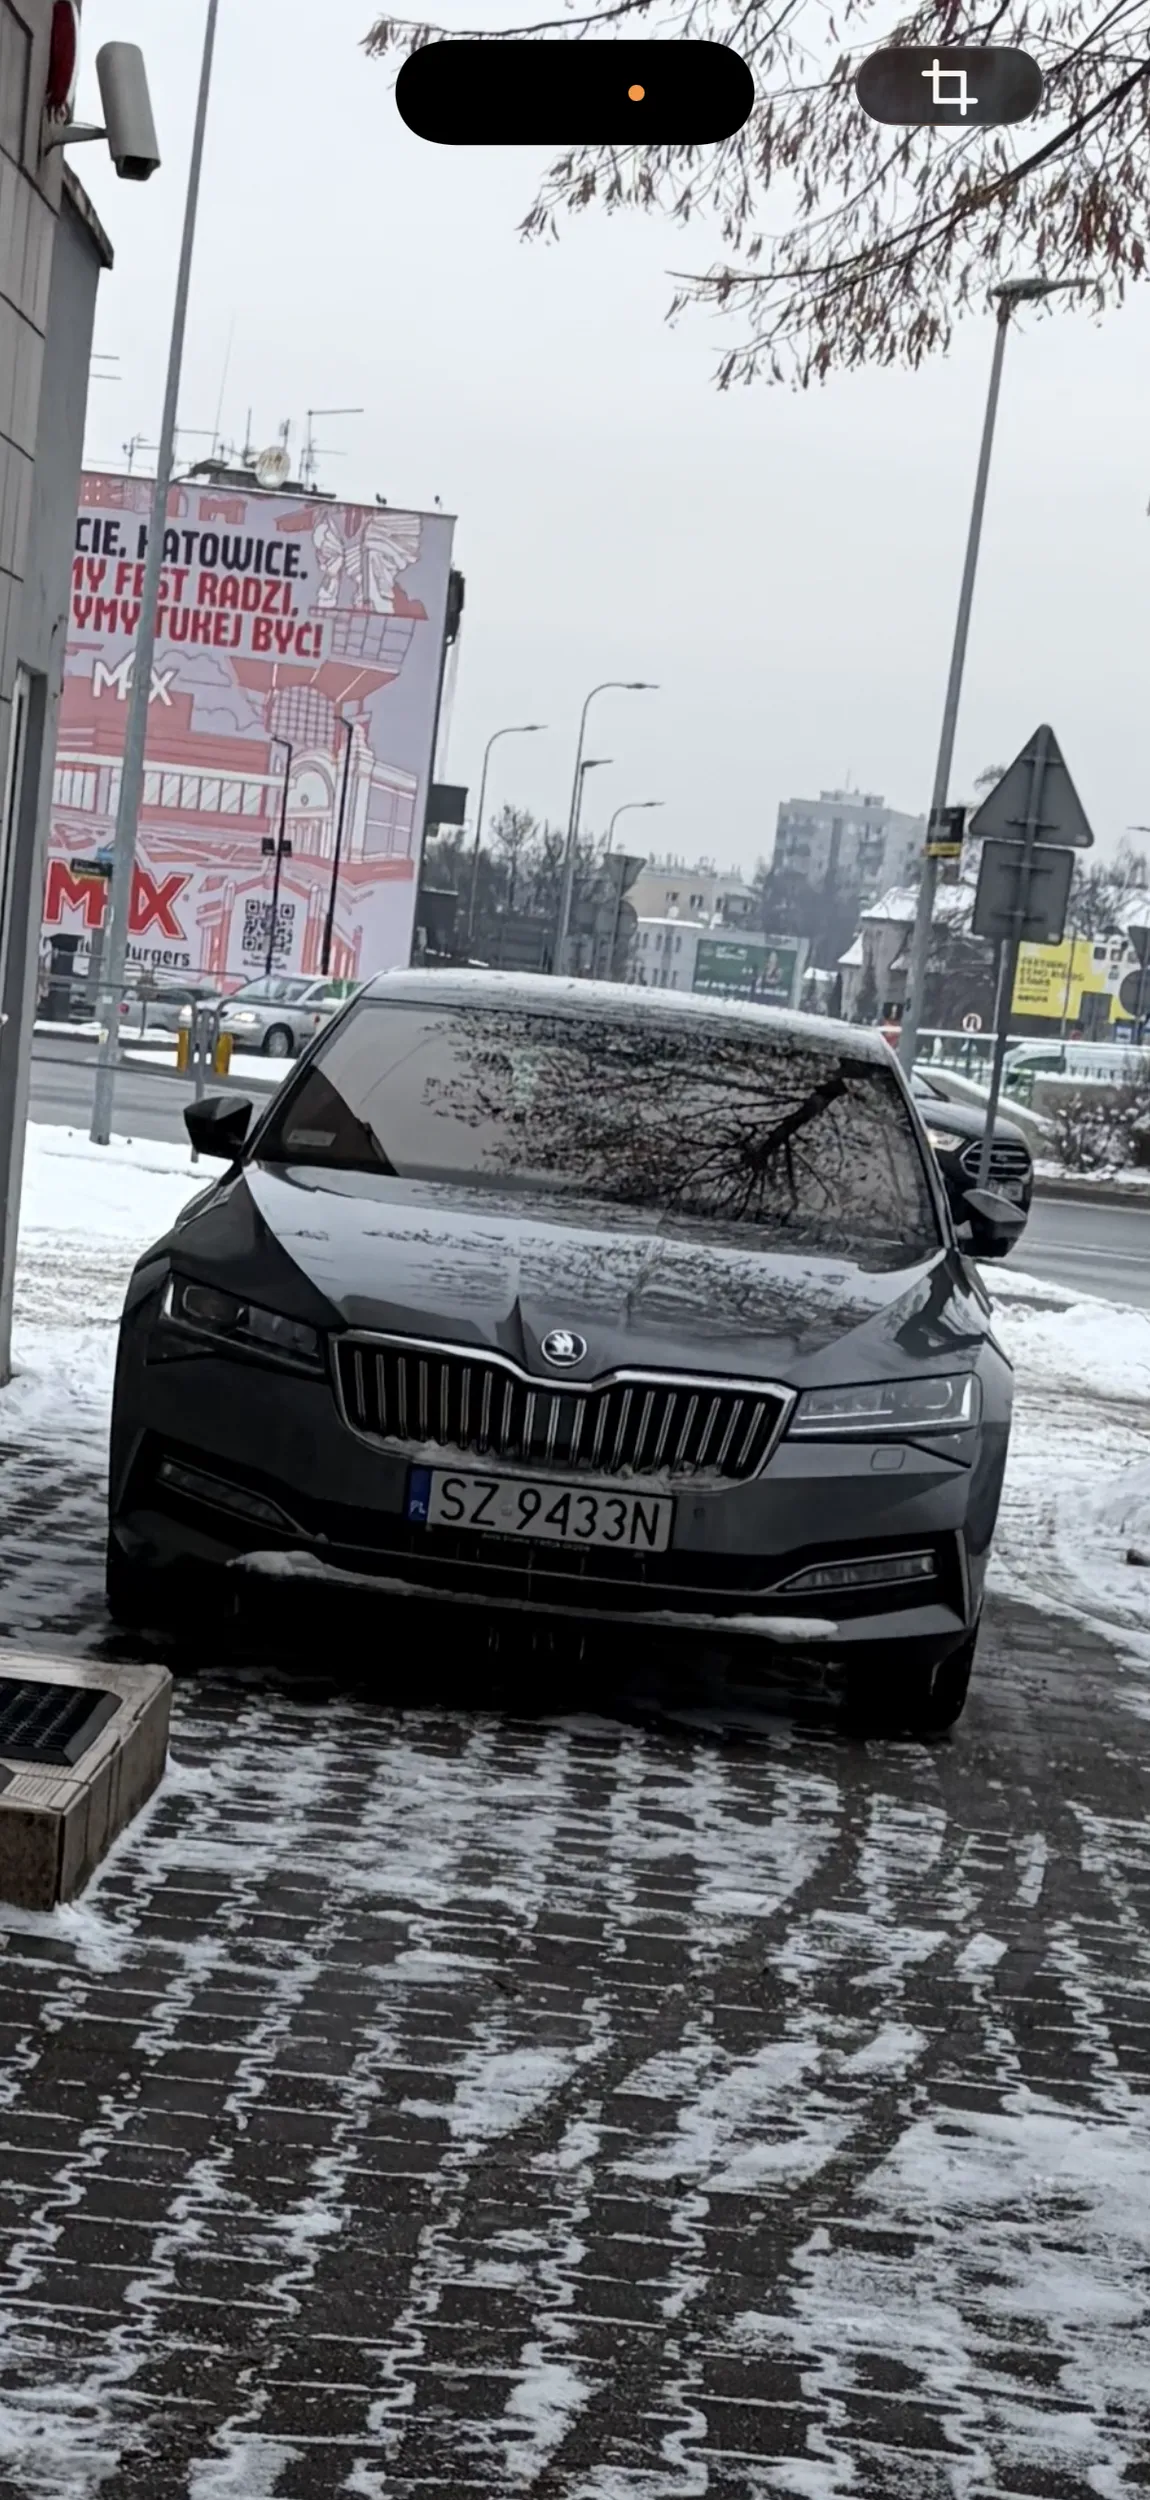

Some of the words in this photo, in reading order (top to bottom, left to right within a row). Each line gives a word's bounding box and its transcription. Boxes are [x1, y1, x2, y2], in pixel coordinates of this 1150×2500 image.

[115, 561, 190, 603] FEST
[154, 605, 243, 648] TUKEJ
[251, 616, 324, 659] BYĆ!
[409, 1500, 427, 1515] PL
[440, 1477, 500, 1527] SZ
[516, 1487, 660, 1547] 9433N
